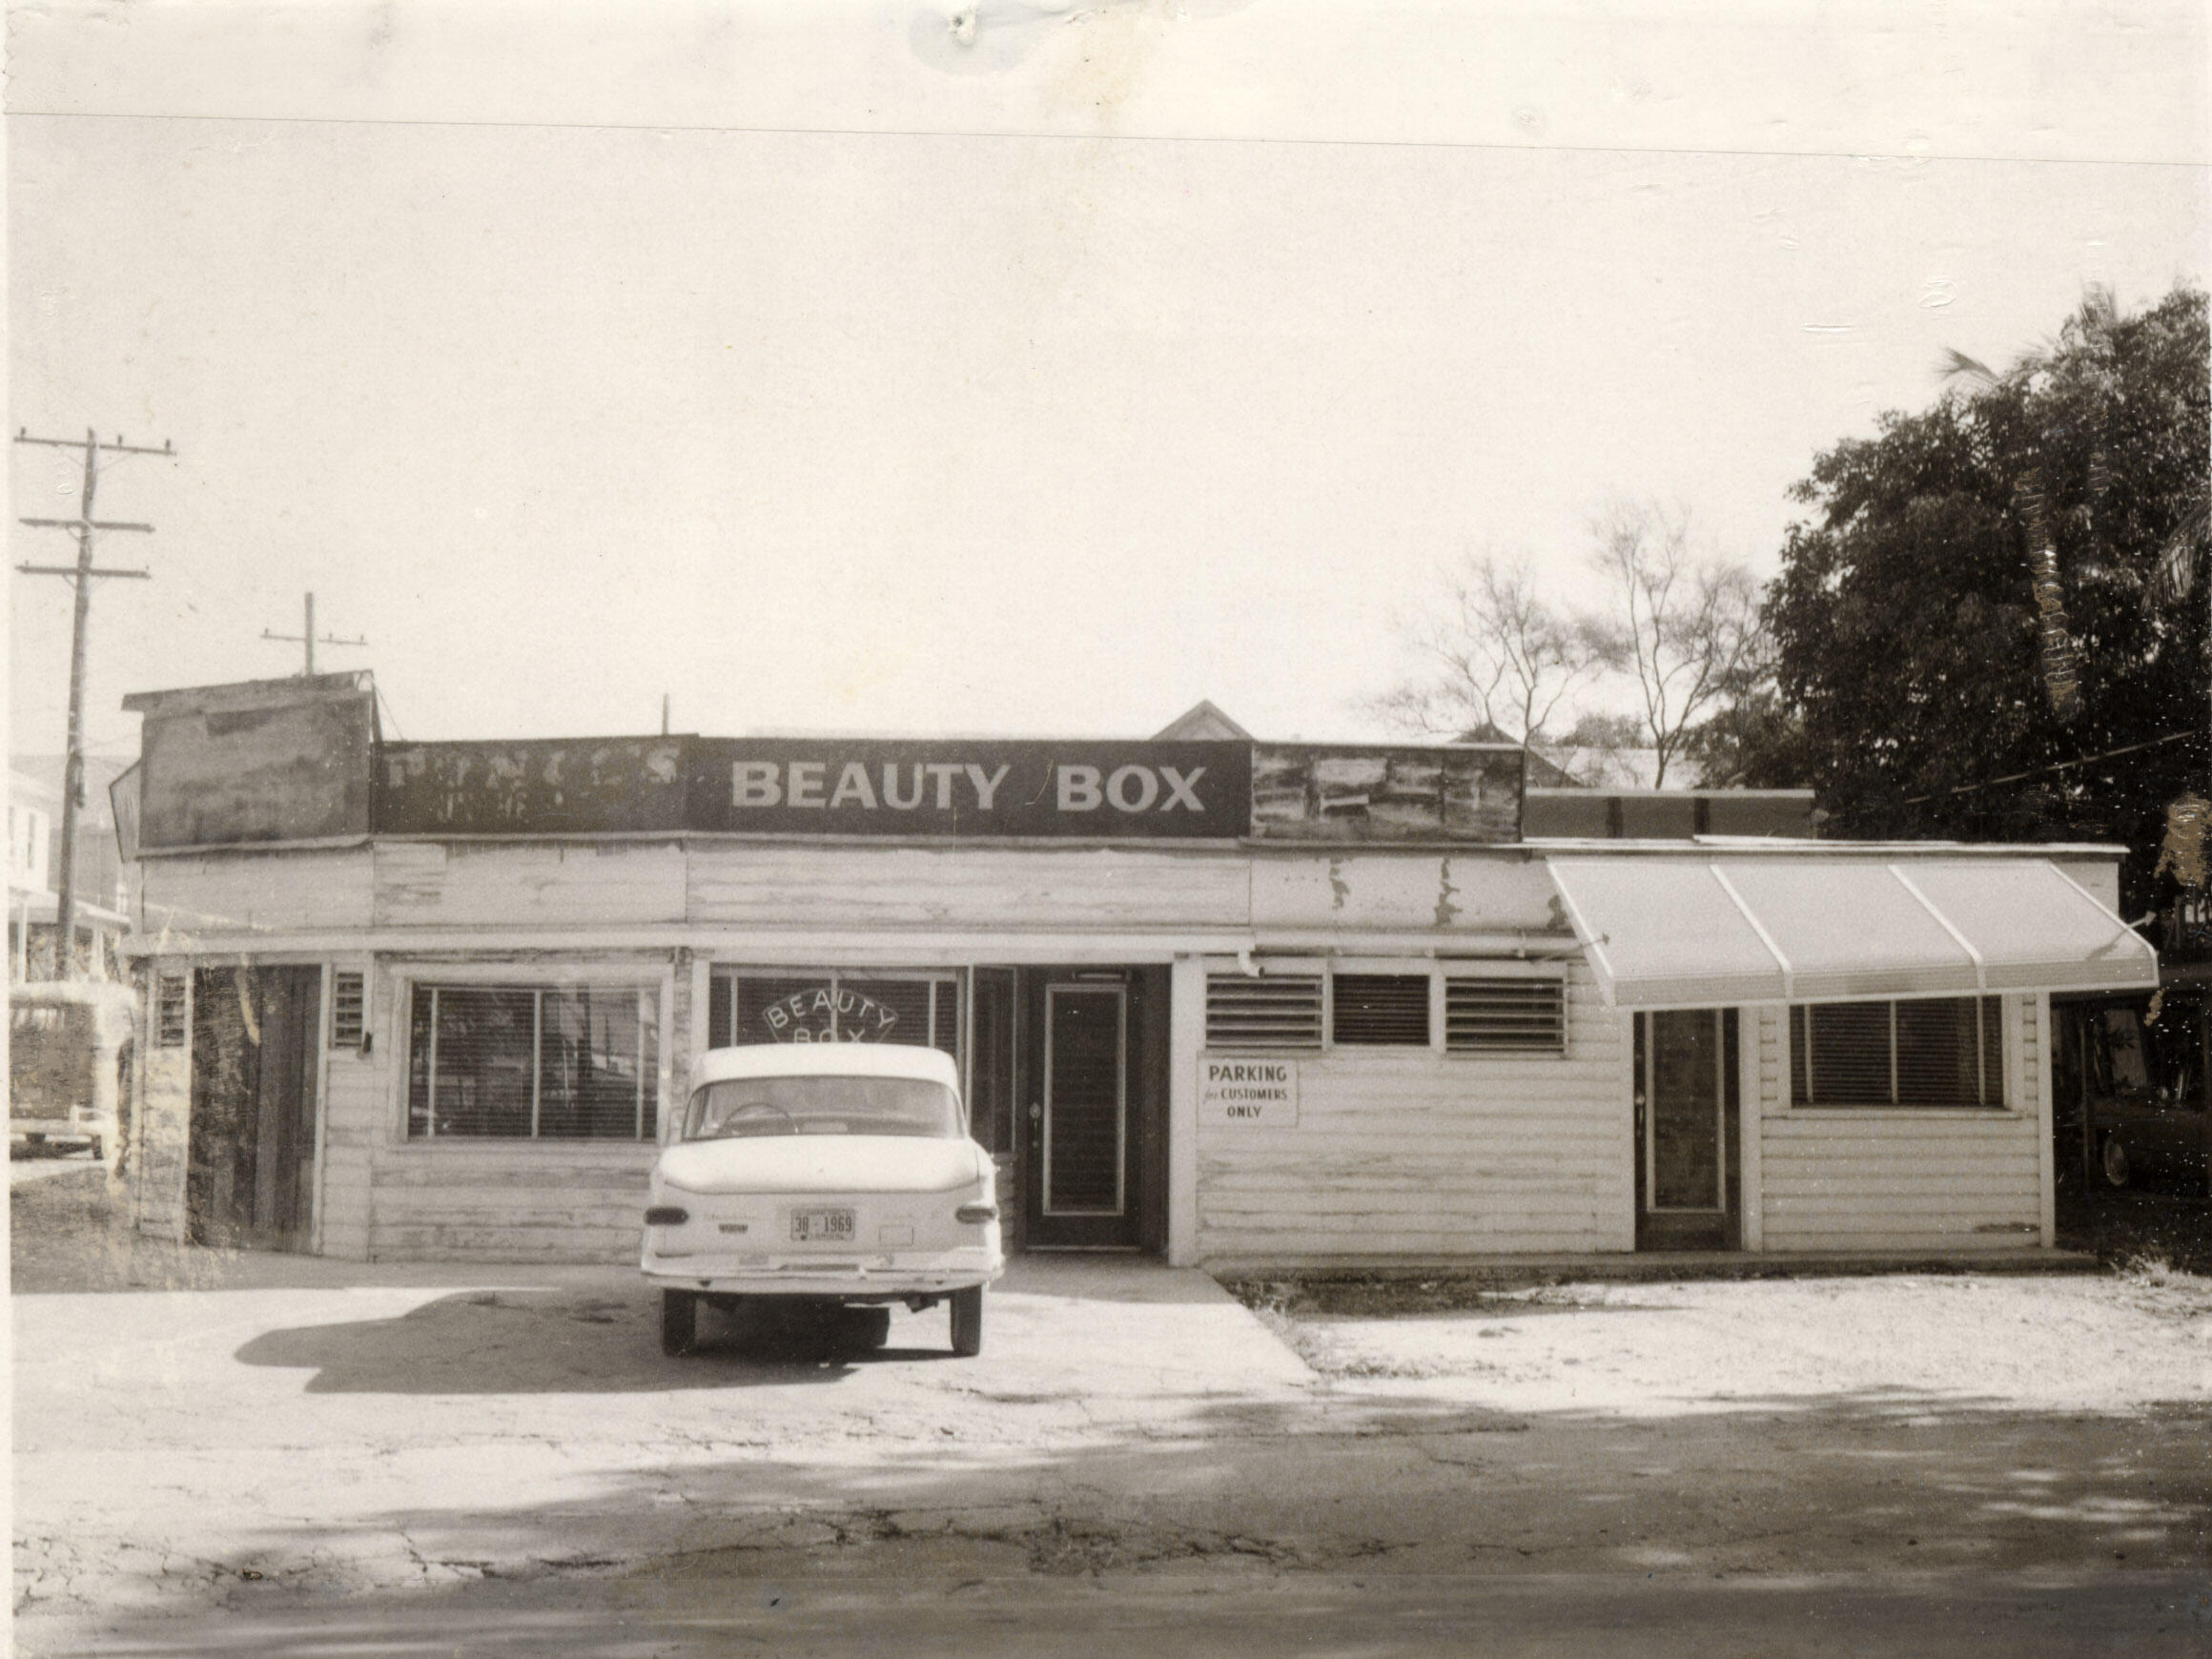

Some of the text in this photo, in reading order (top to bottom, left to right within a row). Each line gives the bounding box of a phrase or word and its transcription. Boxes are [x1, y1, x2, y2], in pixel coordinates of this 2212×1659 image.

[731, 761, 1011, 810] BEAUTY
[1056, 764, 1208, 812] BOX
[768, 989, 896, 1029] BEAUTY
[1208, 1065, 1287, 1082] PARKING
[1220, 1088, 1288, 1100] CUSTOMERS
[1227, 1105, 1263, 1118] ONLY
